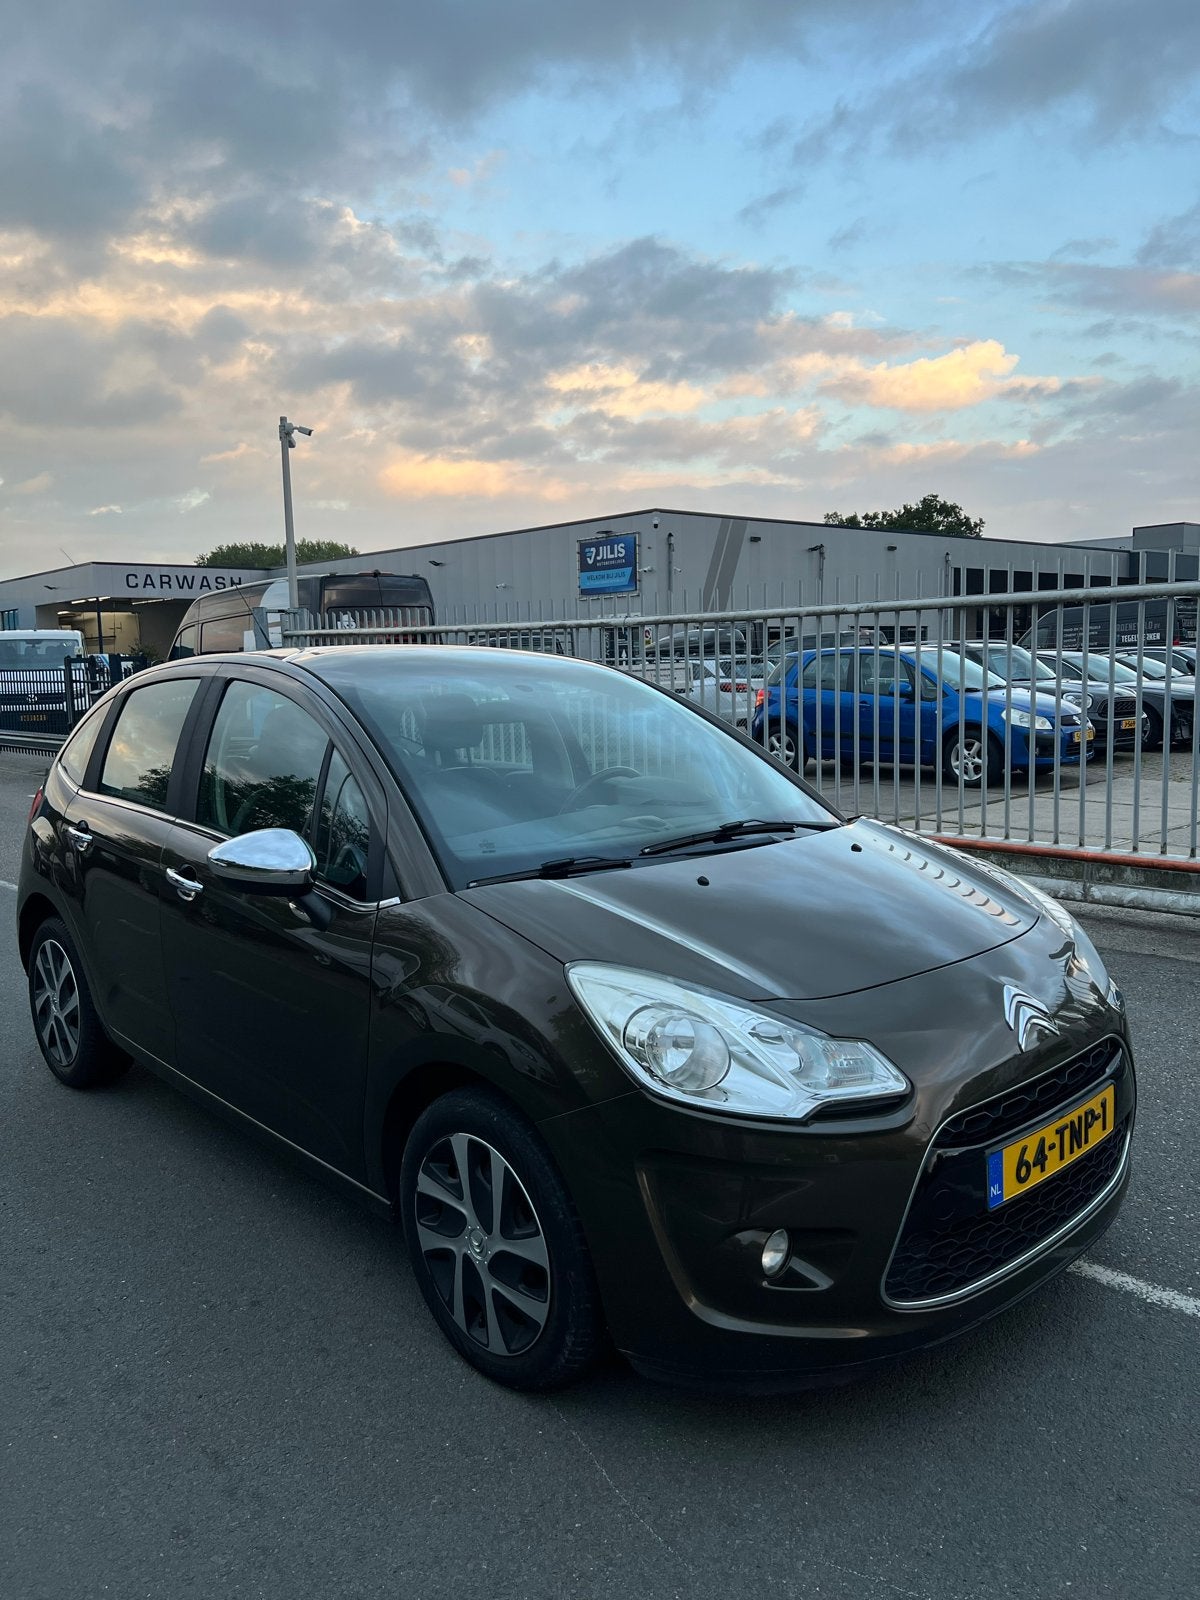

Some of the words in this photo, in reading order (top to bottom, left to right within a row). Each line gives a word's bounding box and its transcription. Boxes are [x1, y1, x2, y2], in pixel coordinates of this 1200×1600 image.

[596, 543, 626, 561] JILIS
[125, 573, 242, 591] CARWASH
[1015, 1096, 1107, 1184] 64-TNP-1
[990, 1183, 1002, 1198] NL
